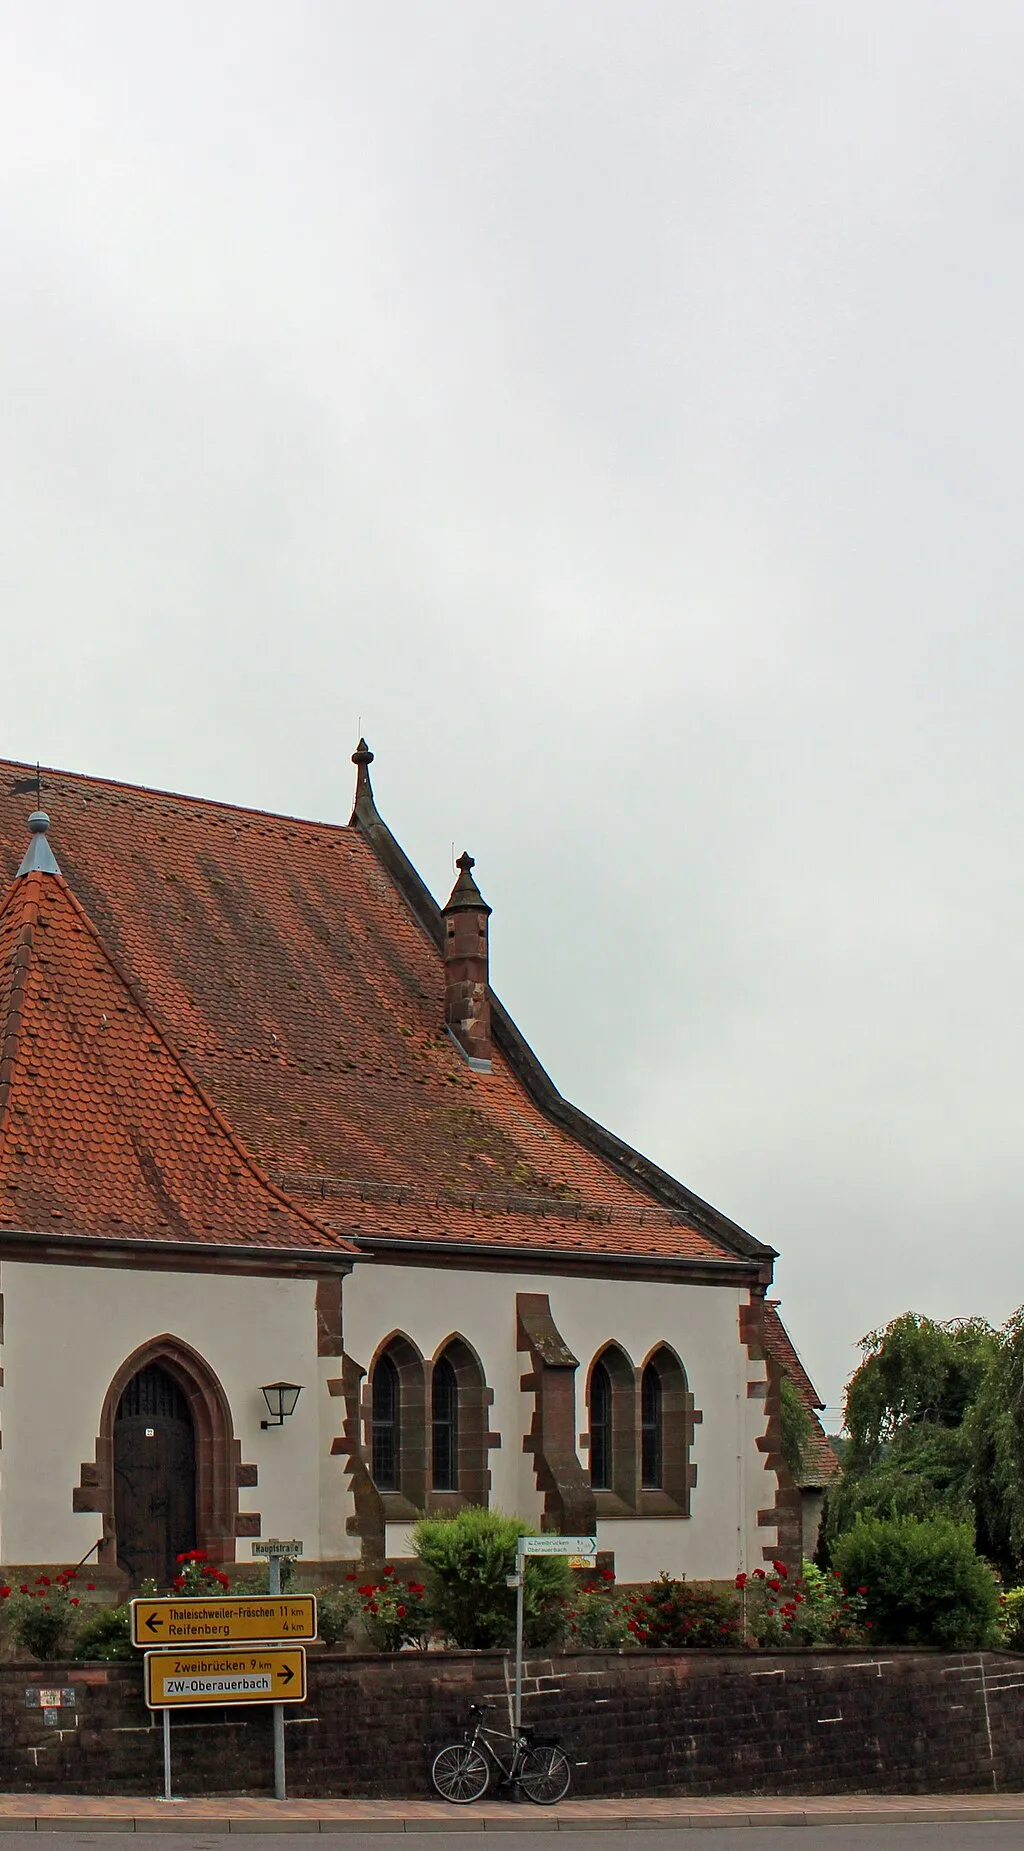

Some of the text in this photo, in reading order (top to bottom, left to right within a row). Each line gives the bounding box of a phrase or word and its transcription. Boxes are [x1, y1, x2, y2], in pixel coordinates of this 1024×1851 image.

[169, 1606, 304, 1621] Thaleischweiler-Fröschen 11 km
[168, 1624, 230, 1636] Reifenberg
[282, 1621, 289, 1631] 4
[174, 1659, 272, 1673] Zweibrücken 9 km
[167, 1677, 269, 1693] ZW-Oberauerbach
